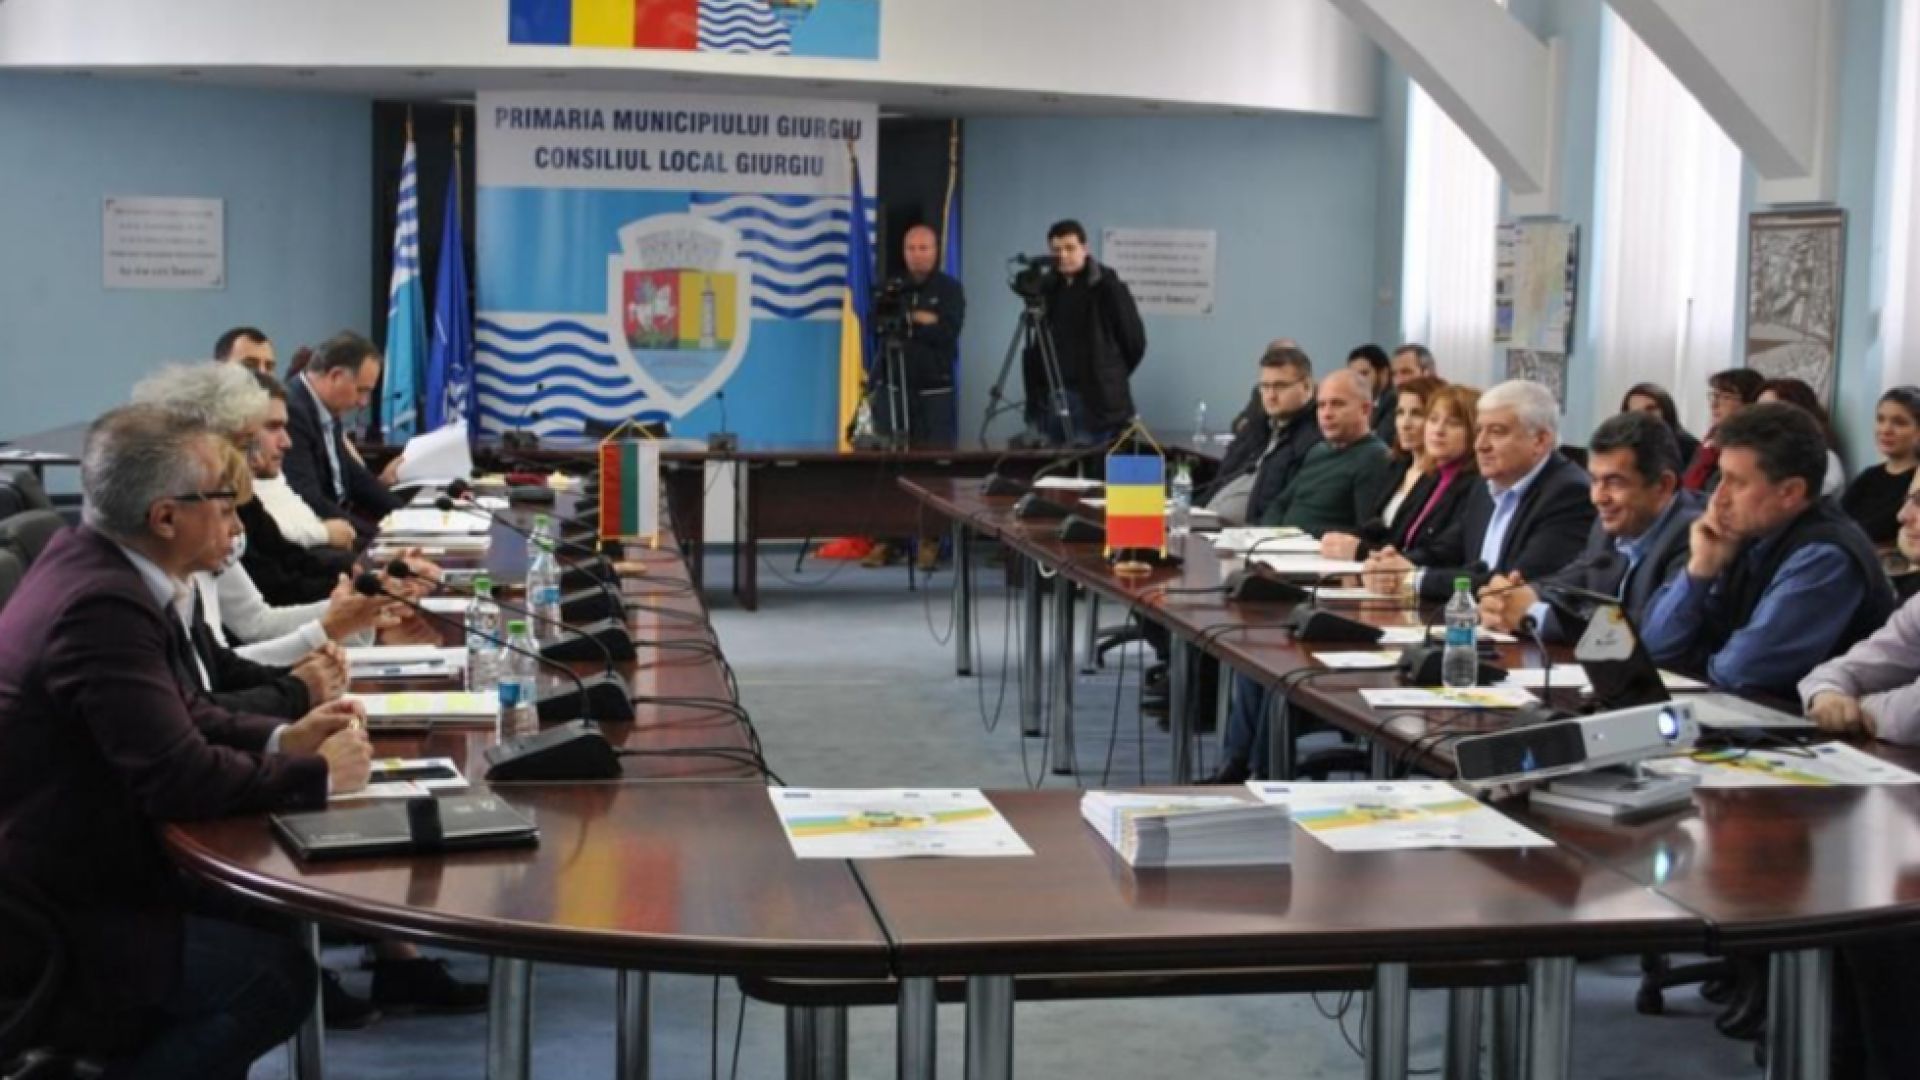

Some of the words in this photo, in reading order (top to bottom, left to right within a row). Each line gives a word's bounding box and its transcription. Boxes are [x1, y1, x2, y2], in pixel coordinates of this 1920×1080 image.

[495, 107, 605, 130] PRIMARIA
[613, 109, 769, 136] MUNICIPIULUI
[776, 115, 862, 141] GIURGIU
[534, 146, 652, 171] CONSILIUL
[659, 149, 728, 173] LOCAL
[736, 152, 824, 176] GIURGIU
